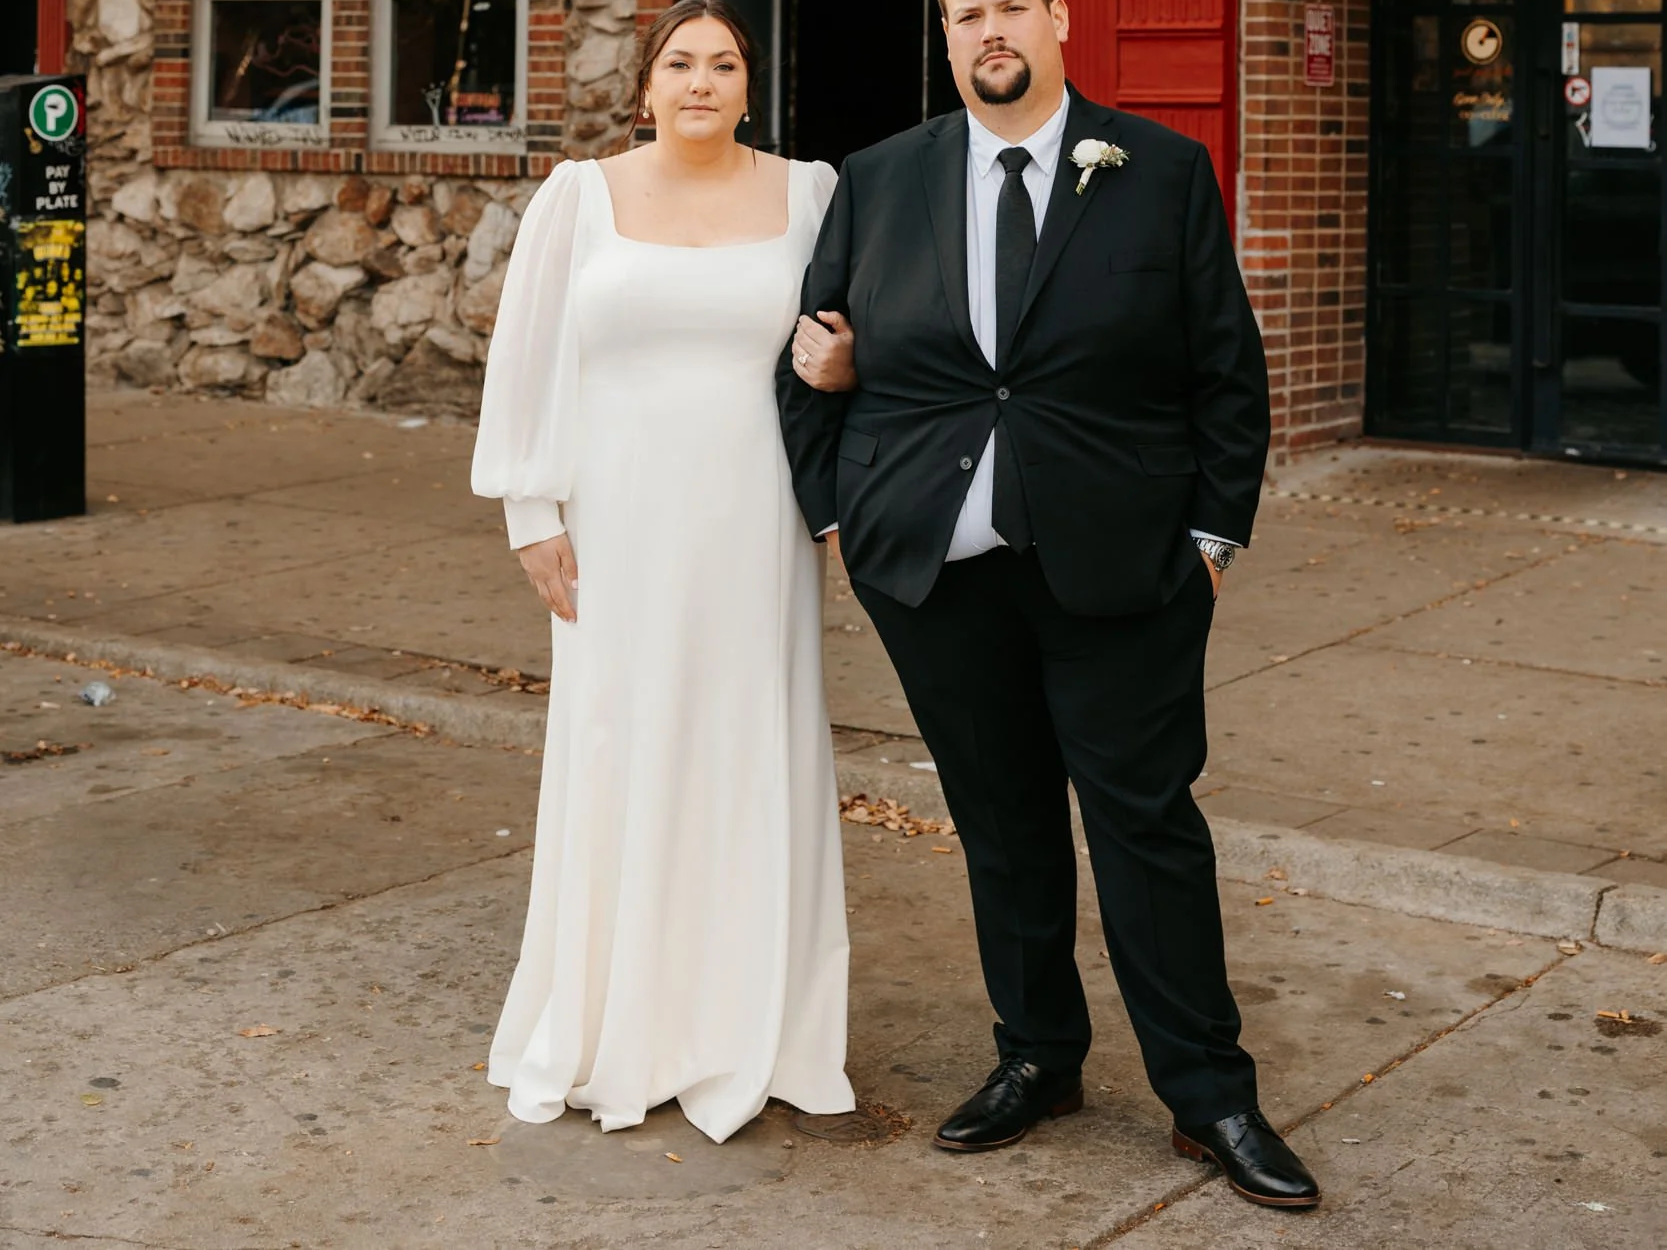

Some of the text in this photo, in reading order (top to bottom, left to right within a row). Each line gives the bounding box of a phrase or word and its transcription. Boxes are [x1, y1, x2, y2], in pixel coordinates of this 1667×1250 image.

[44, 93, 68, 132] P
[45, 165, 71, 180] PAY
[48, 180, 67, 195] BY
[35, 194, 79, 210] PLATE
